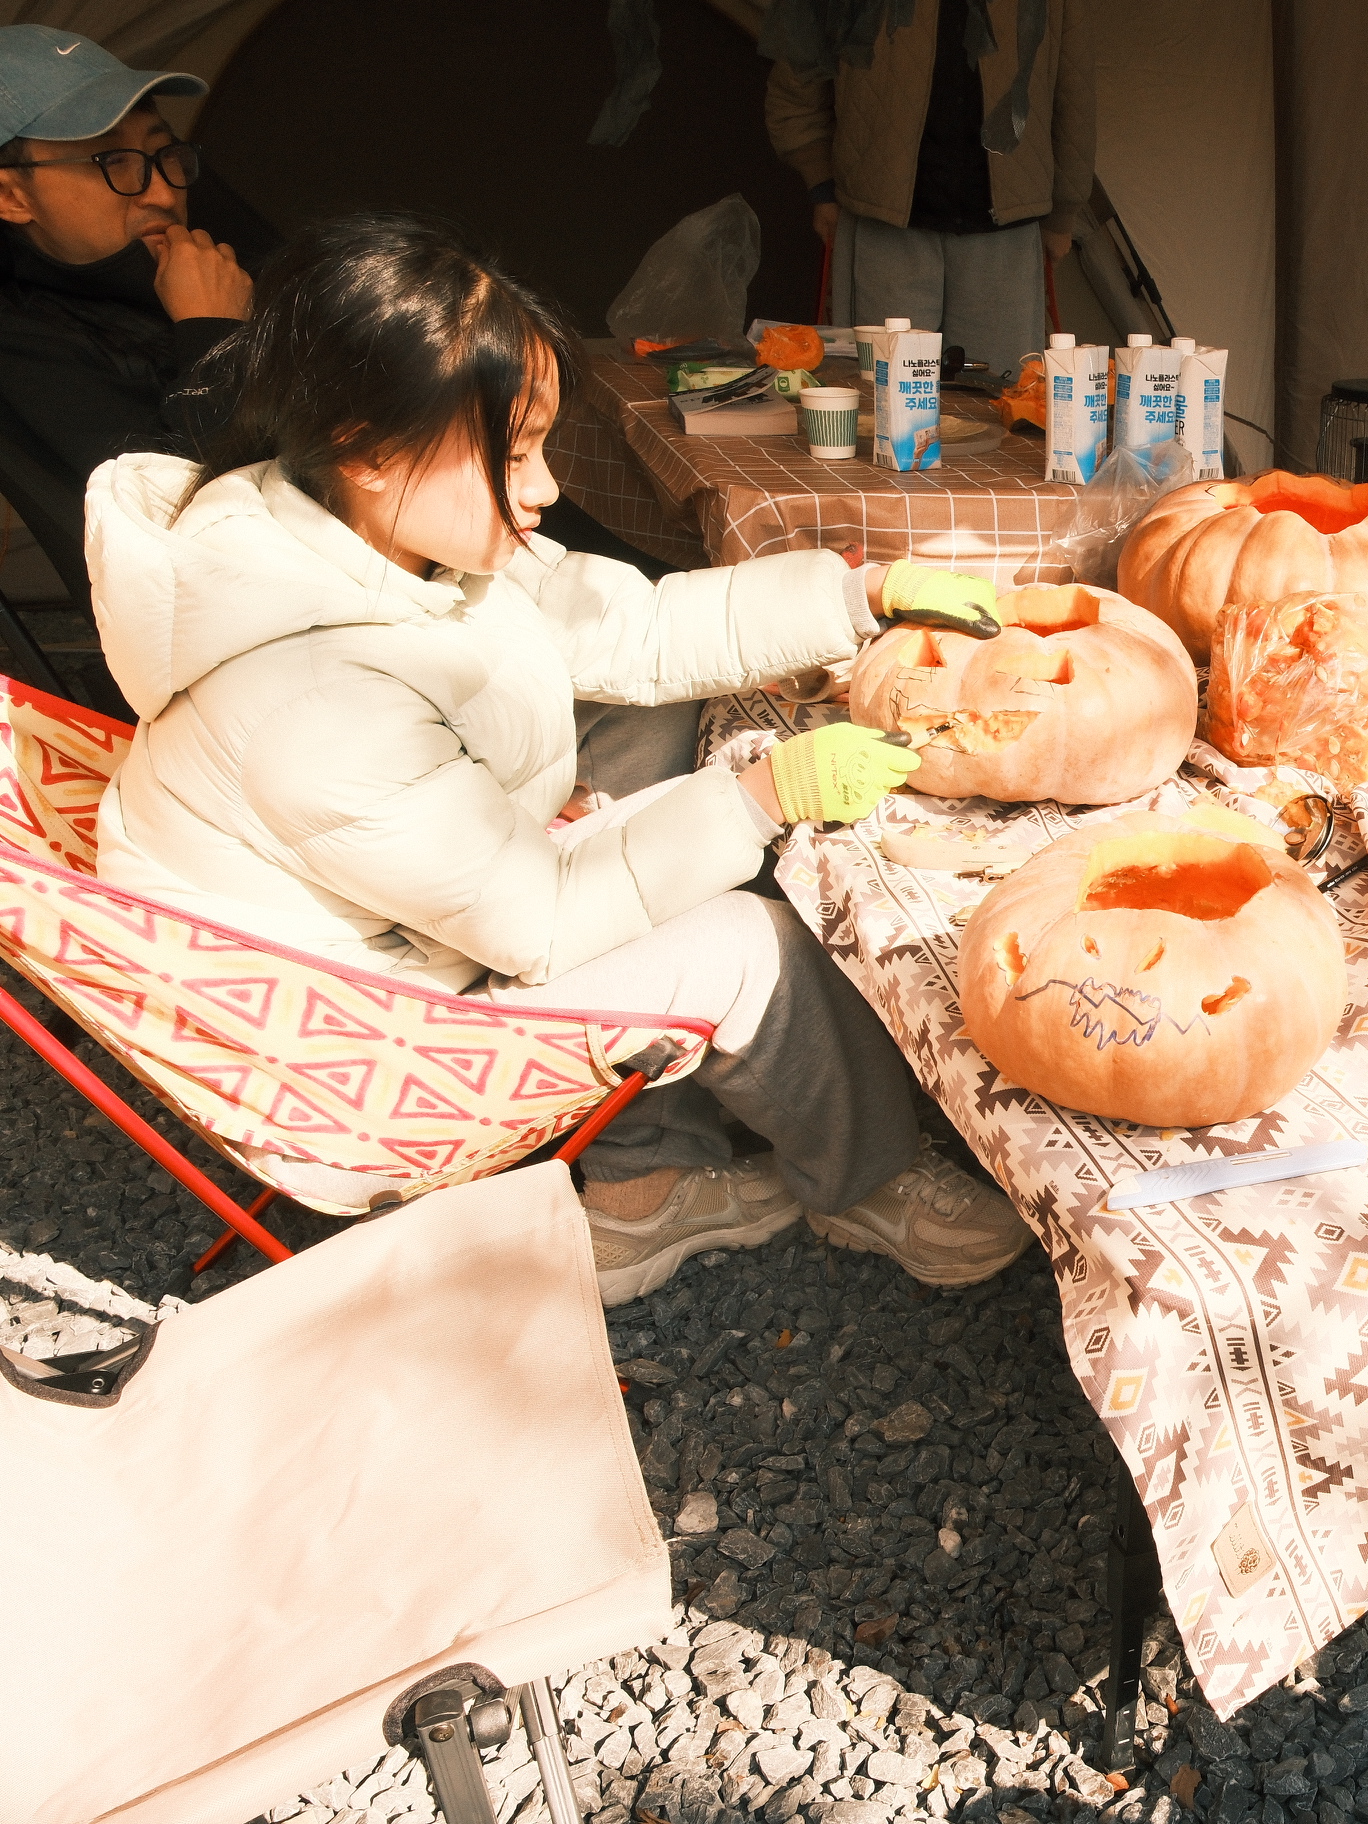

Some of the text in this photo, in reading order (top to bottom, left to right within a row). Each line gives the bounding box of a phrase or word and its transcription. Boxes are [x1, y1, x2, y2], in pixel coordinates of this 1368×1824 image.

[899, 381, 933, 394] 깨끗한
[905, 397, 938, 410] 주세요
[1139, 394, 1173, 408] 깨끗한
[1144, 410, 1177, 424] 주세요
